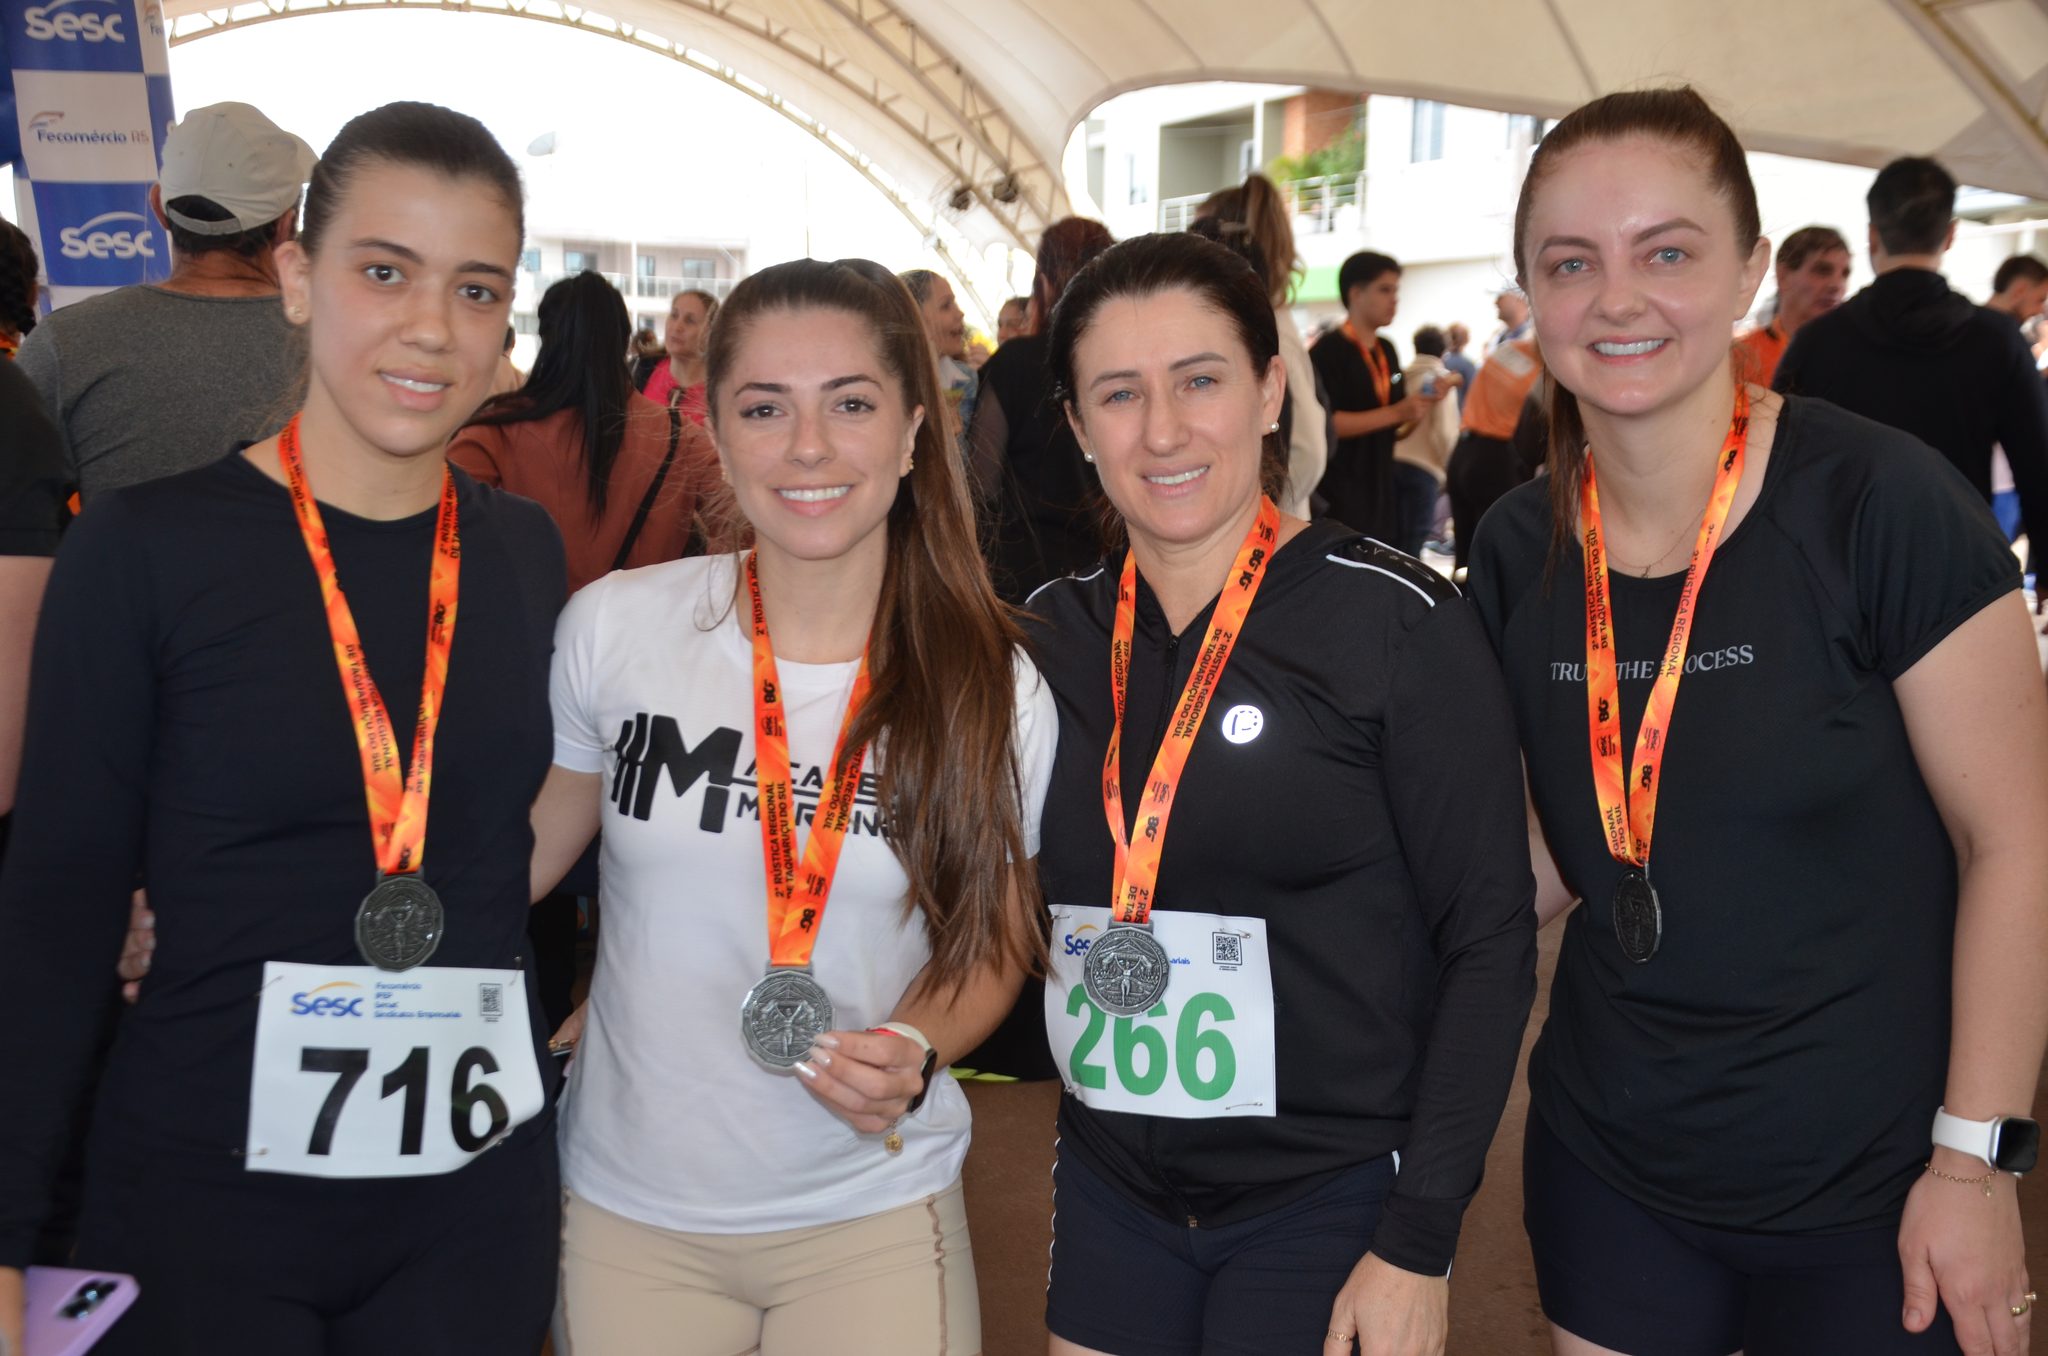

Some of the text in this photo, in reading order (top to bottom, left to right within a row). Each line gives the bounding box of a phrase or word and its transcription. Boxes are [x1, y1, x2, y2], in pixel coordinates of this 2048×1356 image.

[25, 7, 125, 42] Sesc
[37, 129, 127, 144] Fecomércio
[60, 227, 155, 260] Sesc
[1588, 526, 1608, 648] DE TAQUARUÇU DO SUL
[1587, 590, 1598, 637] RÚSTICA
[1115, 640, 1123, 688] REGIONAL
[1203, 643, 1230, 689] RÚSTICA
[1551, 662, 1588, 681] TRU
[1615, 661, 1654, 680] THE
[1682, 644, 1754, 675] OCESS
[1669, 617, 1687, 678] REGIONAL
[1172, 628, 1223, 740] DE TAQUARUÇU DO SUL
[1182, 687, 1209, 742] REGIONAL
[766, 783, 778, 836] REGIONAL
[778, 781, 786, 800] SUL
[779, 802, 787, 817] DO
[835, 780, 855, 833] REGIONAL
[823, 811, 836, 831] SUL
[1615, 803, 1623, 824] SUL
[781, 820, 795, 883] TAQUARUÇU
[1618, 827, 1626, 843] DO
[769, 839, 783, 885] RÚSTICA
[1122, 885, 1139, 924] DE TAQ
[1133, 902, 1149, 925] RÚS
[1065, 934, 1091, 956] Ses
[291, 992, 363, 1016] Sesc
[1066, 983, 1236, 1101] 266
[300, 1046, 510, 1156] 716
